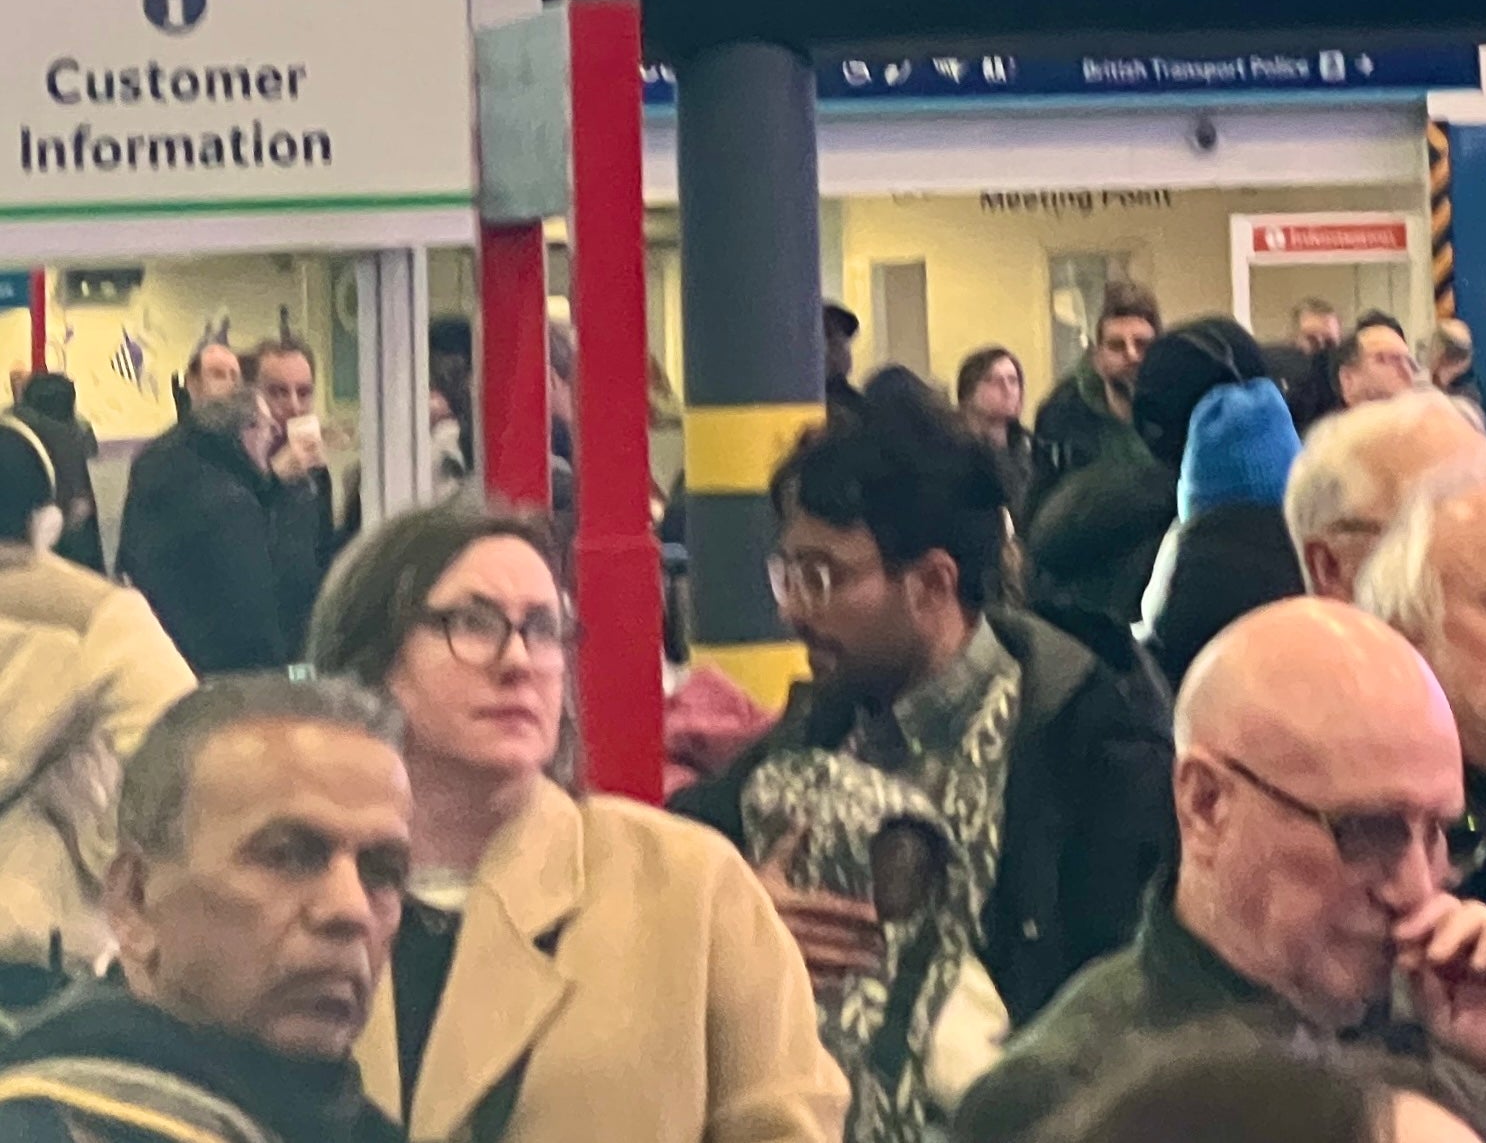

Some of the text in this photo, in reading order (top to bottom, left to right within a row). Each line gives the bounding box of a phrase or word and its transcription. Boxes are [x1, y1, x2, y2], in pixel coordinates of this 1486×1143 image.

[45, 55, 307, 105] Customer
[1082, 54, 1310, 85] British Transport Police
[20, 118, 333, 174] Information
[979, 188, 1094, 216] Meeting
